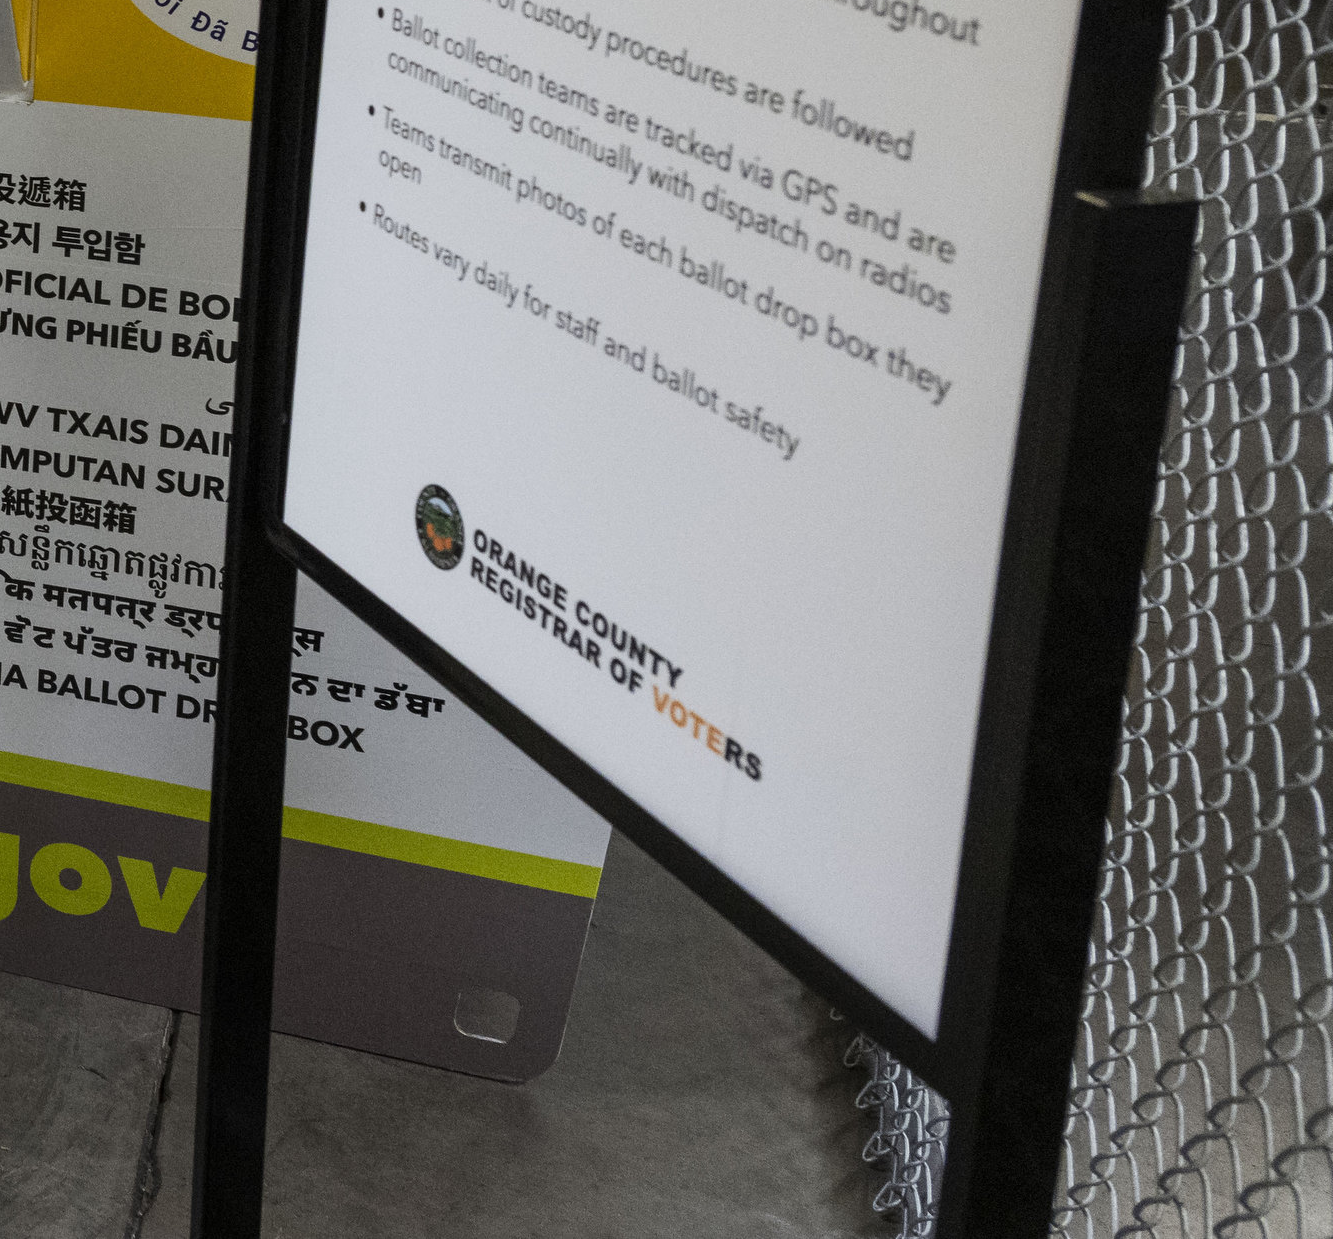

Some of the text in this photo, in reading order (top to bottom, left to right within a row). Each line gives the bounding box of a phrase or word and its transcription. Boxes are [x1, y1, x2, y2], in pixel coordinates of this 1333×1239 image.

[190, 10, 229, 42] Đã
[521, 0, 601, 51] custody
[605, 31, 737, 96] procedures
[744, 82, 784, 113] are
[792, 89, 915, 162] followed
[379, 149, 422, 184] open
[388, 52, 952, 314] communicating continually with dispatch on radios
[391, 8, 956, 264] Ballot collection teams are tracked via GPS and are
[52, 225, 146, 265] 투입함
[121, 283, 168, 313] DE
[384, 106, 952, 406] Teams transmit photos of each ballot drop box they
[66, 319, 162, 354] PHIẾU
[171, 329, 238, 364] BẦU
[373, 203, 799, 461] Routes vary daily for staff and ballot safety
[47, 407, 150, 445] TXAIS
[470, 556, 762, 781] REGISTRAR OF VOTERS
[474, 529, 683, 689] ORANGE COUNTY
[37, 668, 166, 713] BALLOT
[286, 714, 366, 753] BOX
